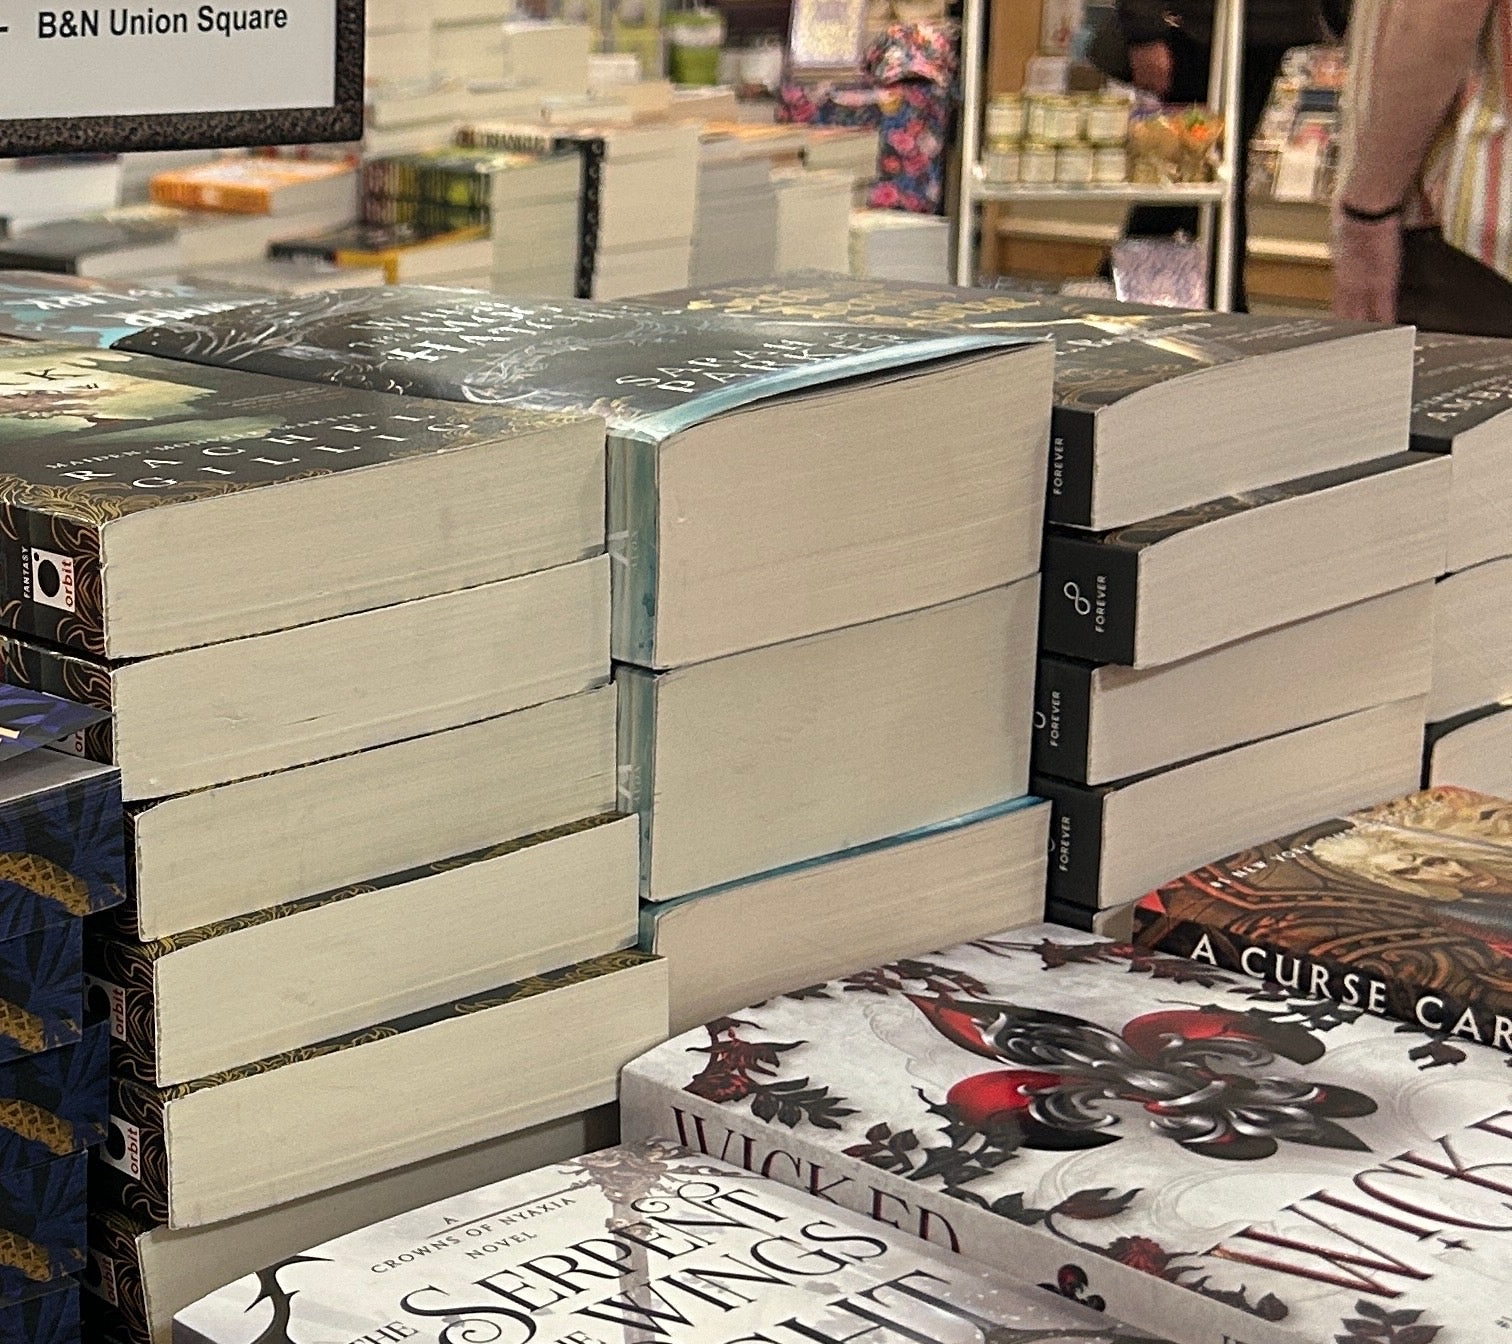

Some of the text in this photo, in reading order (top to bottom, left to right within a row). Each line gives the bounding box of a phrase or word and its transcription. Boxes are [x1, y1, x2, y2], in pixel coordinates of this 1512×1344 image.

[38, 5, 288, 39] B&N Union Square
[615, 338, 816, 388] SARAH
[656, 333, 911, 394] PARKER
[60, 414, 436, 482] RACHEL
[132, 423, 470, 489] GILLIG
[1052, 436, 1065, 496] FOREVER
[21, 545, 31, 599] FANTASY
[60, 558, 75, 609] orbit
[1094, 574, 1108, 634] FOREVER
[1049, 690, 1062, 747] FOREVER
[1059, 815, 1071, 872] FOREVER
[1190, 932, 1222, 966] A
[1240, 946, 1388, 1016] CURSE
[113, 986, 125, 1036] orbit
[128, 1126, 139, 1174] orbit
[371, 1197, 577, 1274] CROWNS OF NYAXIA
[443, 1216, 459, 1225] A
[465, 1230, 538, 1260] NOVEL
[104, 1256, 116, 1302] orbit
[569, 1220, 888, 1338] WINGS
